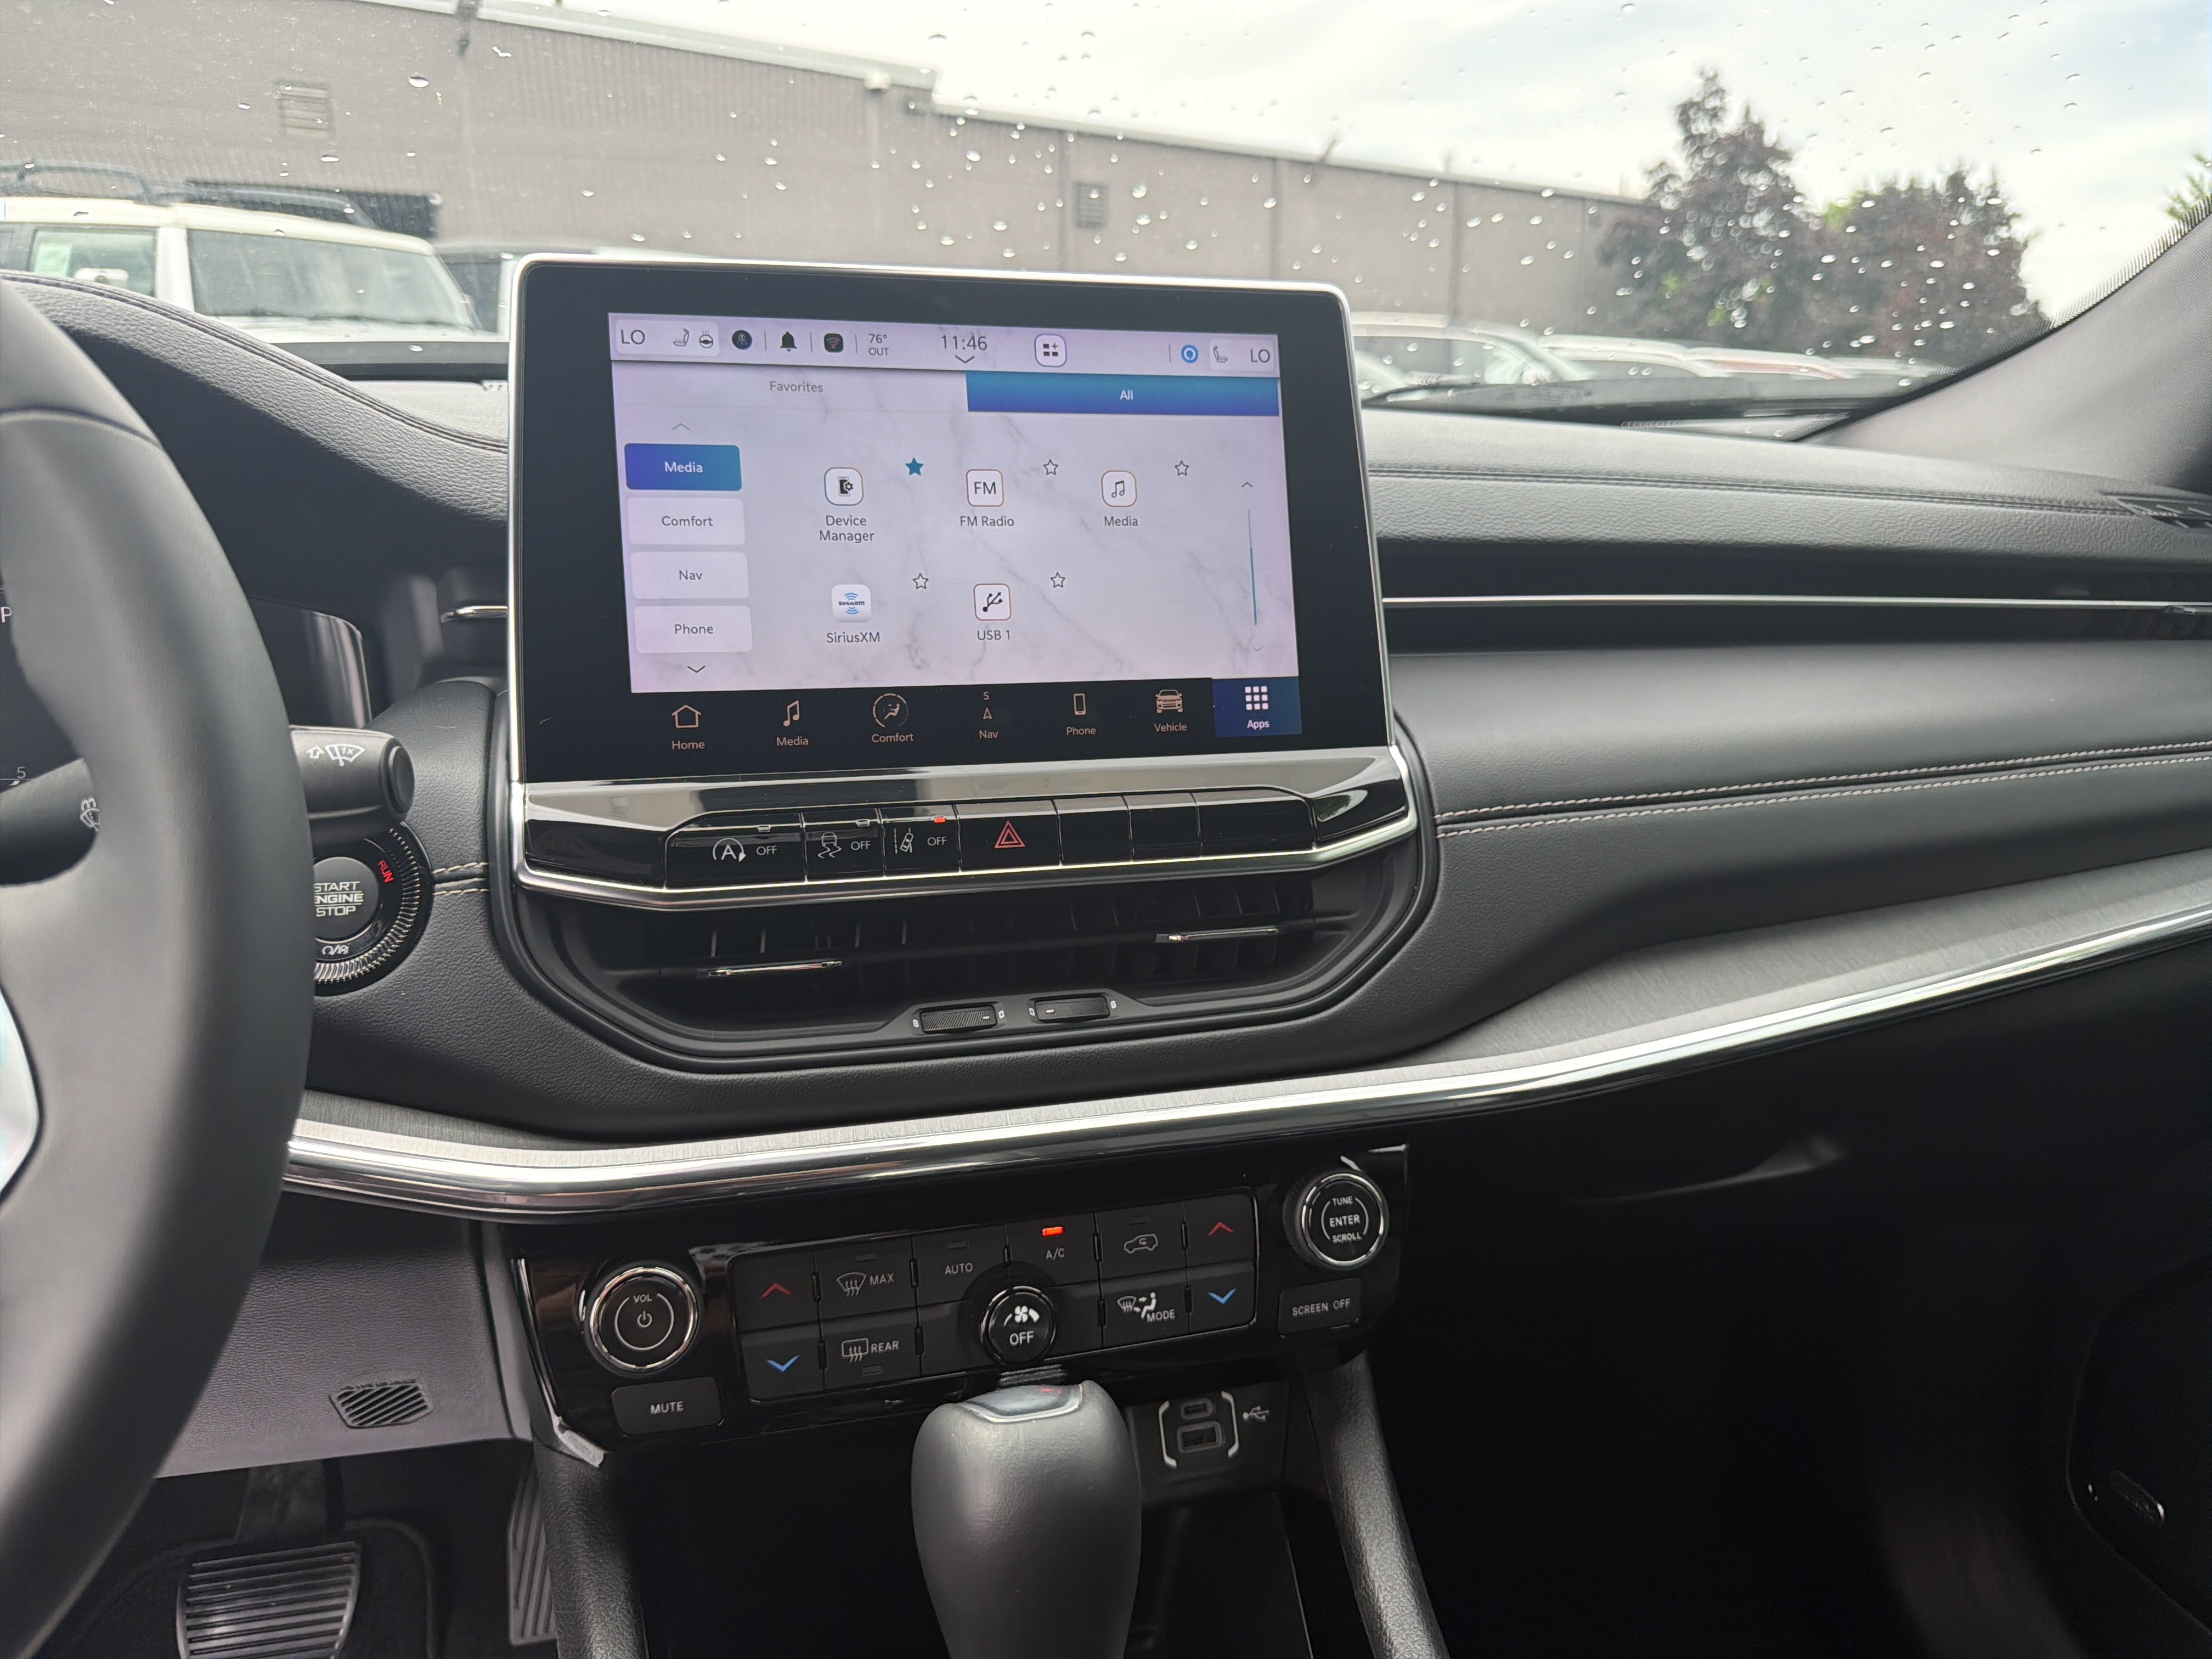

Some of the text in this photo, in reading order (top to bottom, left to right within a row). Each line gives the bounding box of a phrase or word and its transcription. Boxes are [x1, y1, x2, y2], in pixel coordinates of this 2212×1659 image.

[620, 329, 646, 345] LO
[941, 334, 988, 351] 11:46
[868, 347, 889, 356] OUT
[1250, 348, 1271, 363] LO
[770, 381, 823, 393] Favorites
[1120, 390, 1133, 400] All
[664, 461, 703, 473] Media
[974, 482, 996, 494] FM
[662, 515, 713, 527] Comfort
[826, 515, 867, 526] Device
[960, 516, 1014, 527] FM Radio
[1104, 516, 1138, 527] Media
[819, 530, 874, 544] Manager
[679, 570, 703, 580] Nav
[674, 624, 714, 634] Phone
[827, 631, 880, 644] SiriusXM
[977, 629, 1011, 641] USB 1
[1154, 722, 1187, 732] Vehicle
[1246, 719, 1270, 730] Apps
[979, 730, 998, 739] Nav
[1066, 726, 1096, 736] Phone
[776, 736, 809, 747] Media
[871, 732, 914, 743] Comfort
[672, 740, 705, 750] Home
[850, 840, 871, 851] OFF
[927, 836, 947, 846] OFF
[756, 845, 777, 856] OFF
[377, 860, 394, 883] RUN
[313, 881, 360, 893] START
[315, 906, 356, 917] STOP
[1332, 1196, 1353, 1205] TUNE
[1329, 1214, 1360, 1227] ENTER
[1332, 1232, 1362, 1243] SCROLL
[1046, 1248, 1065, 1260] A/C
[945, 1262, 973, 1275] AUTO
[870, 1273, 894, 1285] MAX
[633, 1294, 653, 1303] VOL
[1292, 1298, 1351, 1316] SCREEN OFF
[1147, 1309, 1176, 1322] MODE
[1009, 1330, 1034, 1345] OFF
[871, 1340, 899, 1353] REAR
[650, 1401, 684, 1414] MUTE
